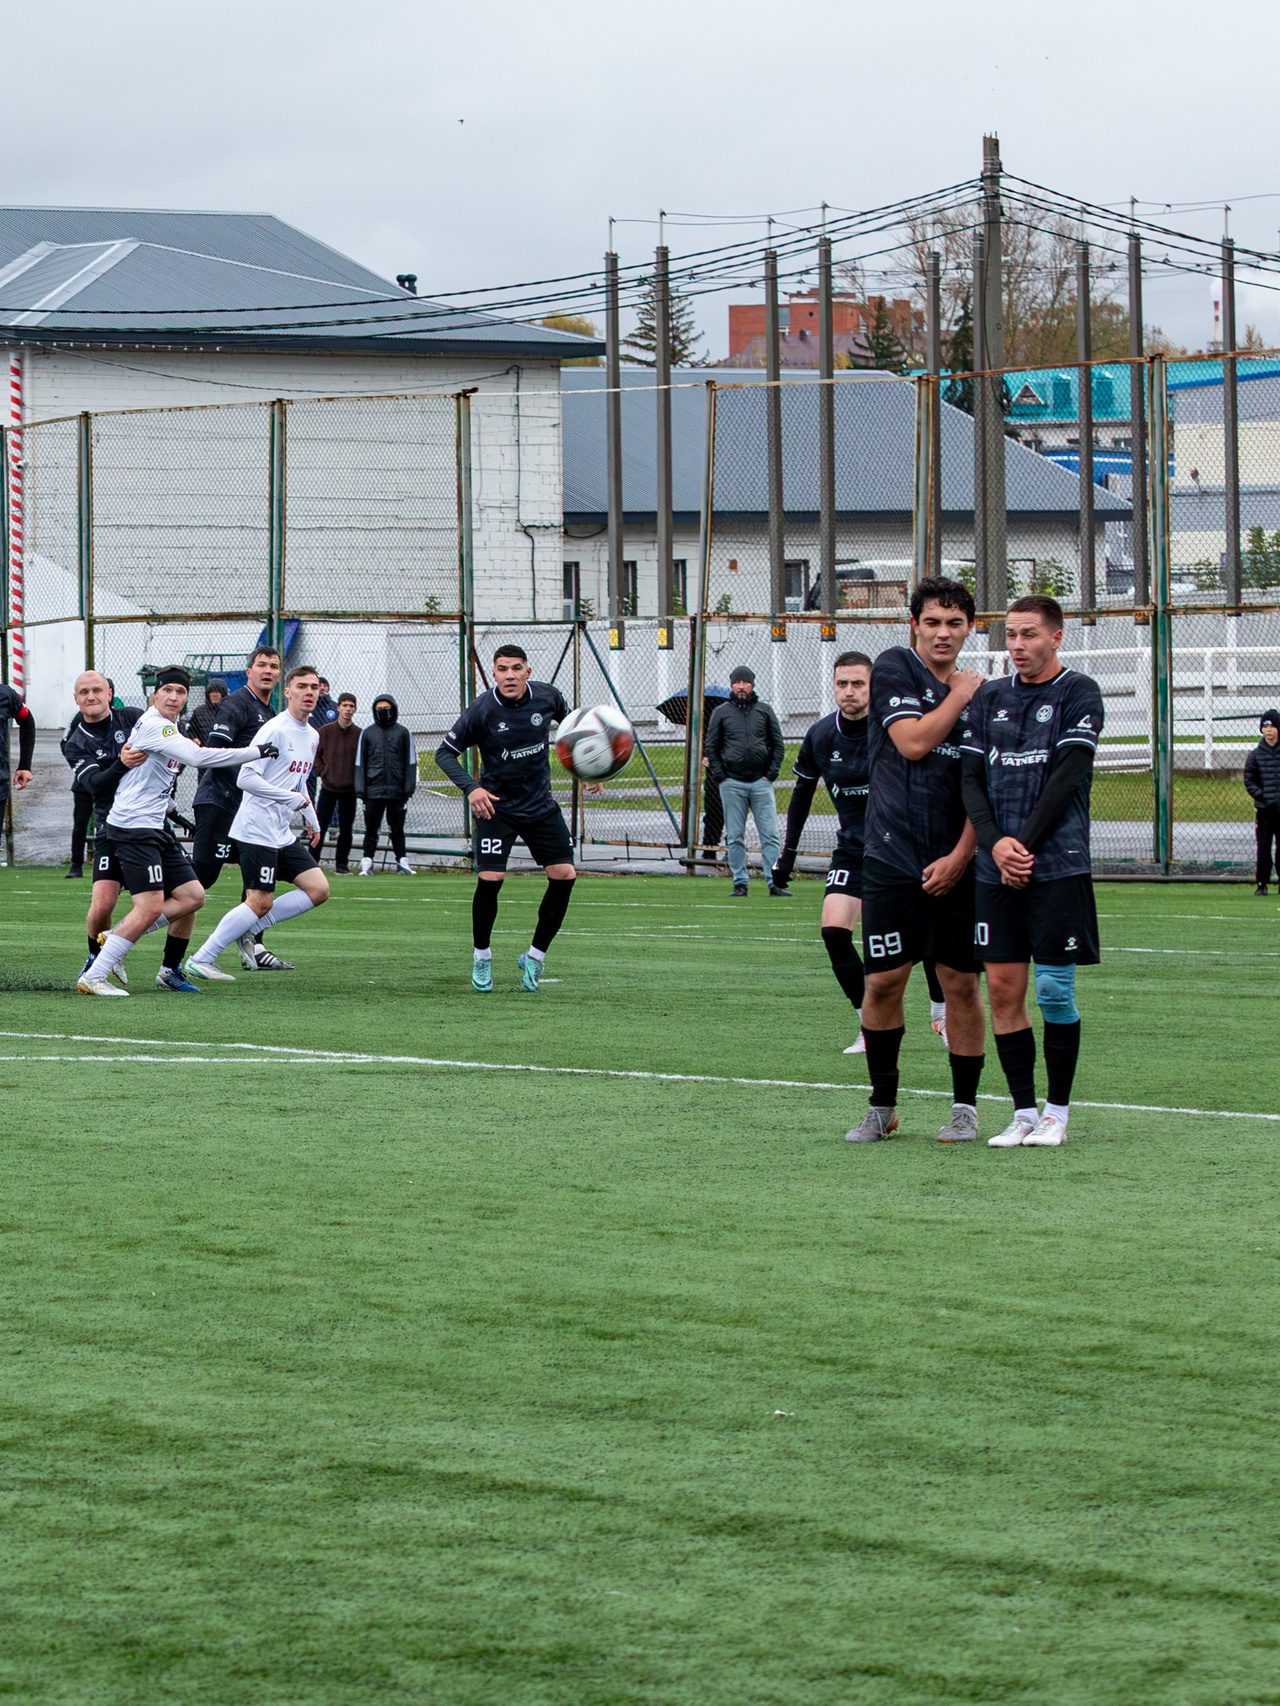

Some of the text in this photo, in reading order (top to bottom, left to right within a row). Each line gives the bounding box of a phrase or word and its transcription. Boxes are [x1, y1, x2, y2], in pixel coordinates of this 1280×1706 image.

[1001, 754, 1049, 767] TATNEFT
[481, 838, 502, 854] 92
[98, 856, 110, 871] 8
[147, 864, 163, 883] 10
[259, 866, 275, 884] 91
[825, 869, 850, 887] 90
[869, 931, 902, 958] 69
